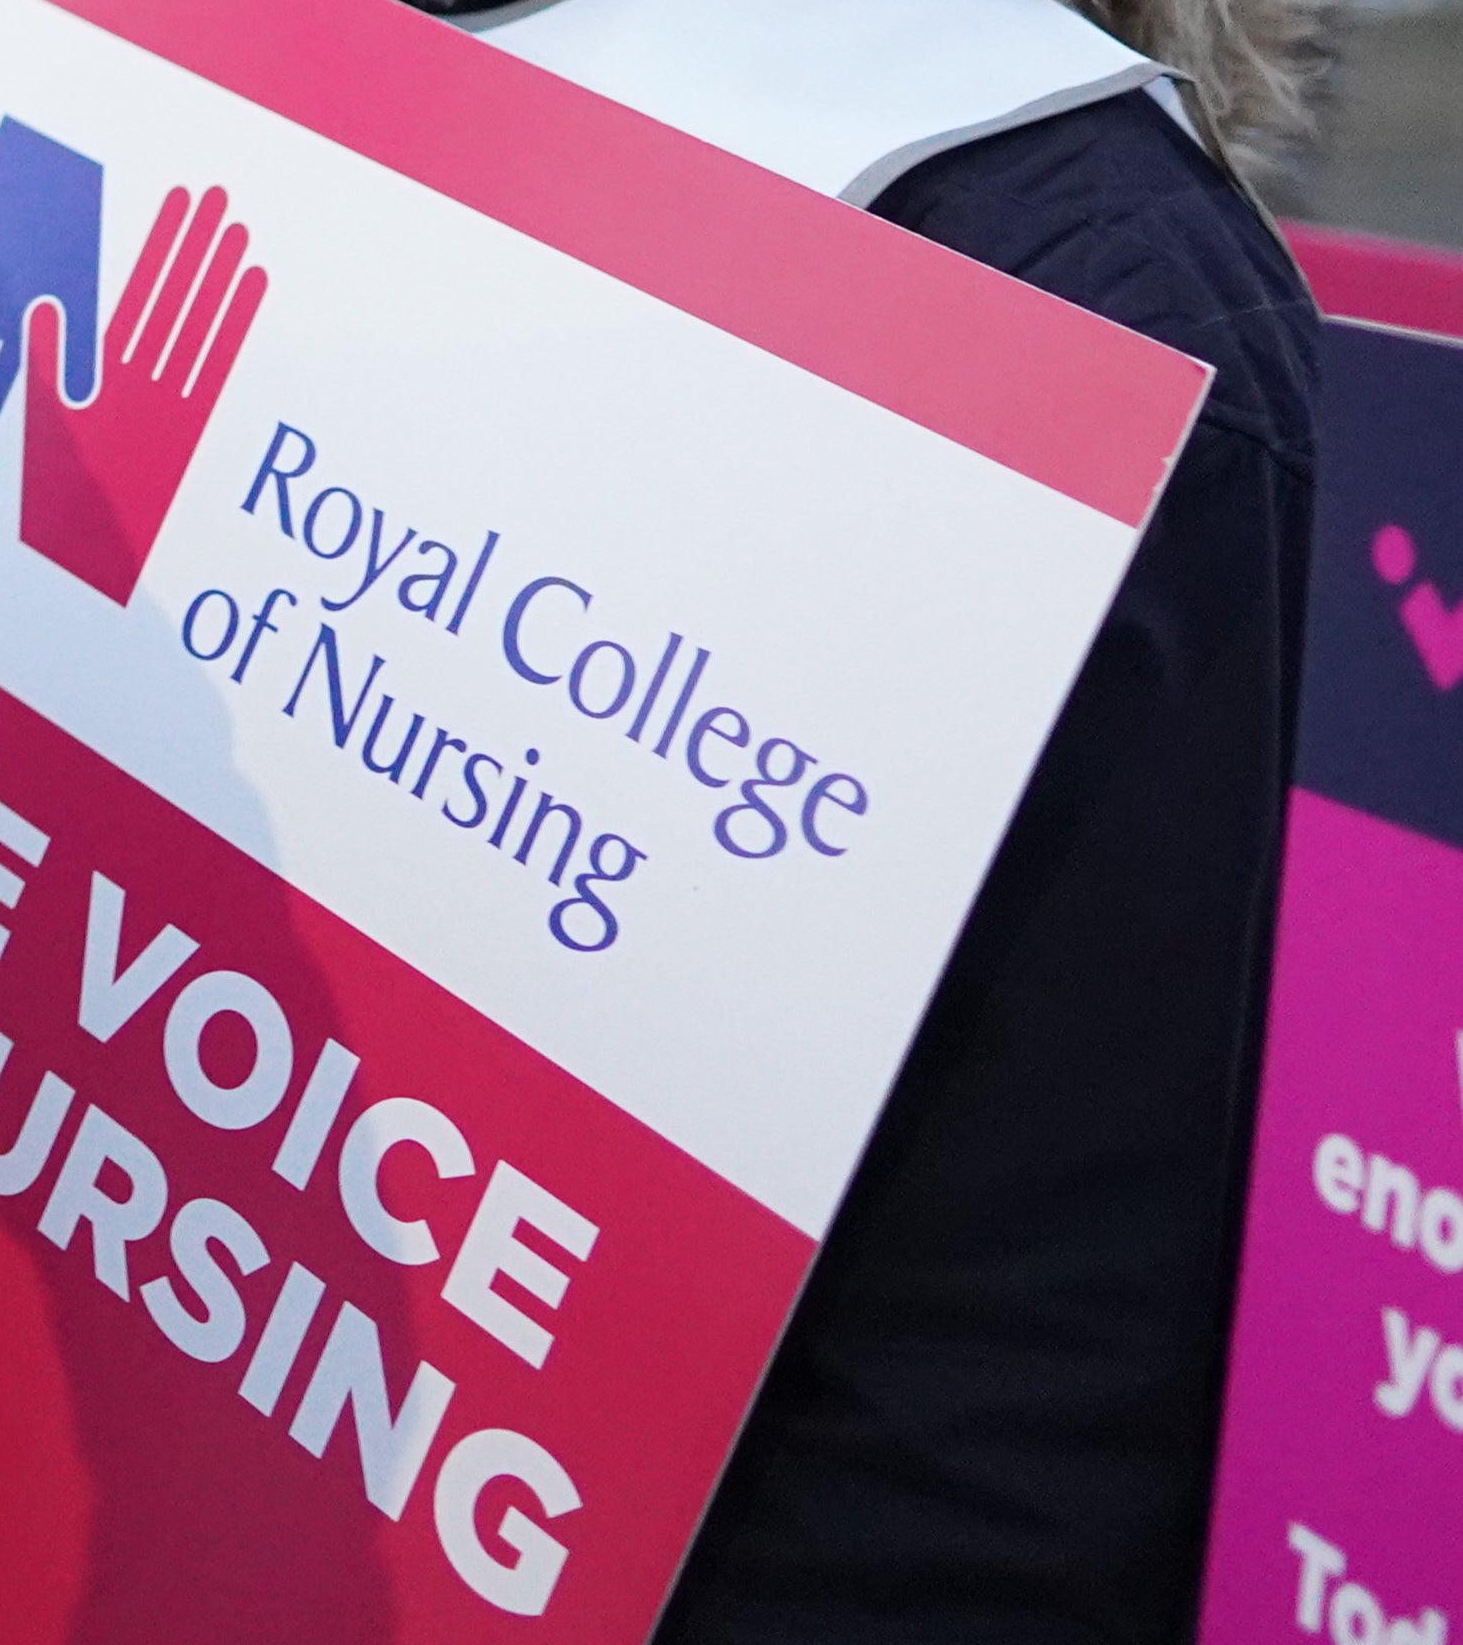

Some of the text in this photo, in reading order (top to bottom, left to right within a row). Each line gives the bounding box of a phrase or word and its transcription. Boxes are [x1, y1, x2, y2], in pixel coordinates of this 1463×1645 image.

[180, 585, 648, 954] of Nursing
[238, 419, 870, 861] Royal College
[77, 869, 602, 1371] VOICE
